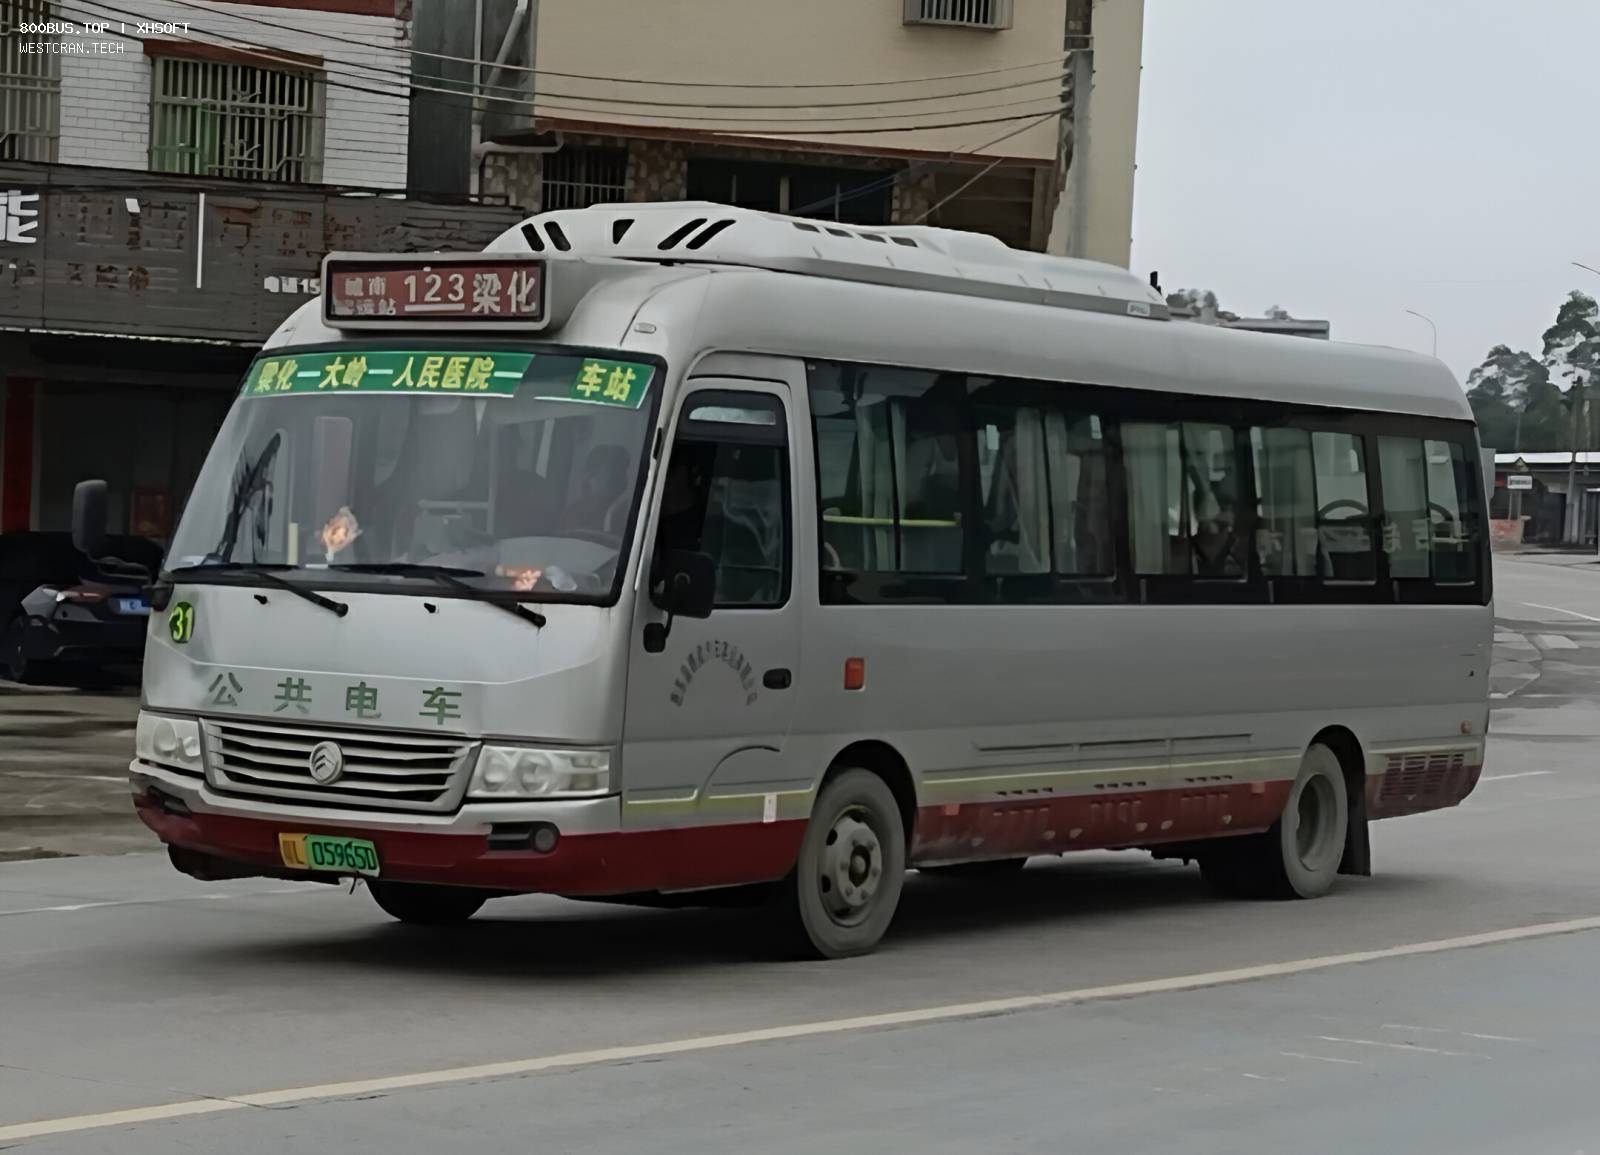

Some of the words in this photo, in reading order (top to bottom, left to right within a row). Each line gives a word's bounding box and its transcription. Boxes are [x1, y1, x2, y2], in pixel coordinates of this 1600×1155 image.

[404, 273, 465, 302] 123
[472, 271, 536, 313] 梁化
[576, 363, 637, 402] 车站
[169, 606, 193, 641] 31
[208, 672, 462, 726] 公共电车
